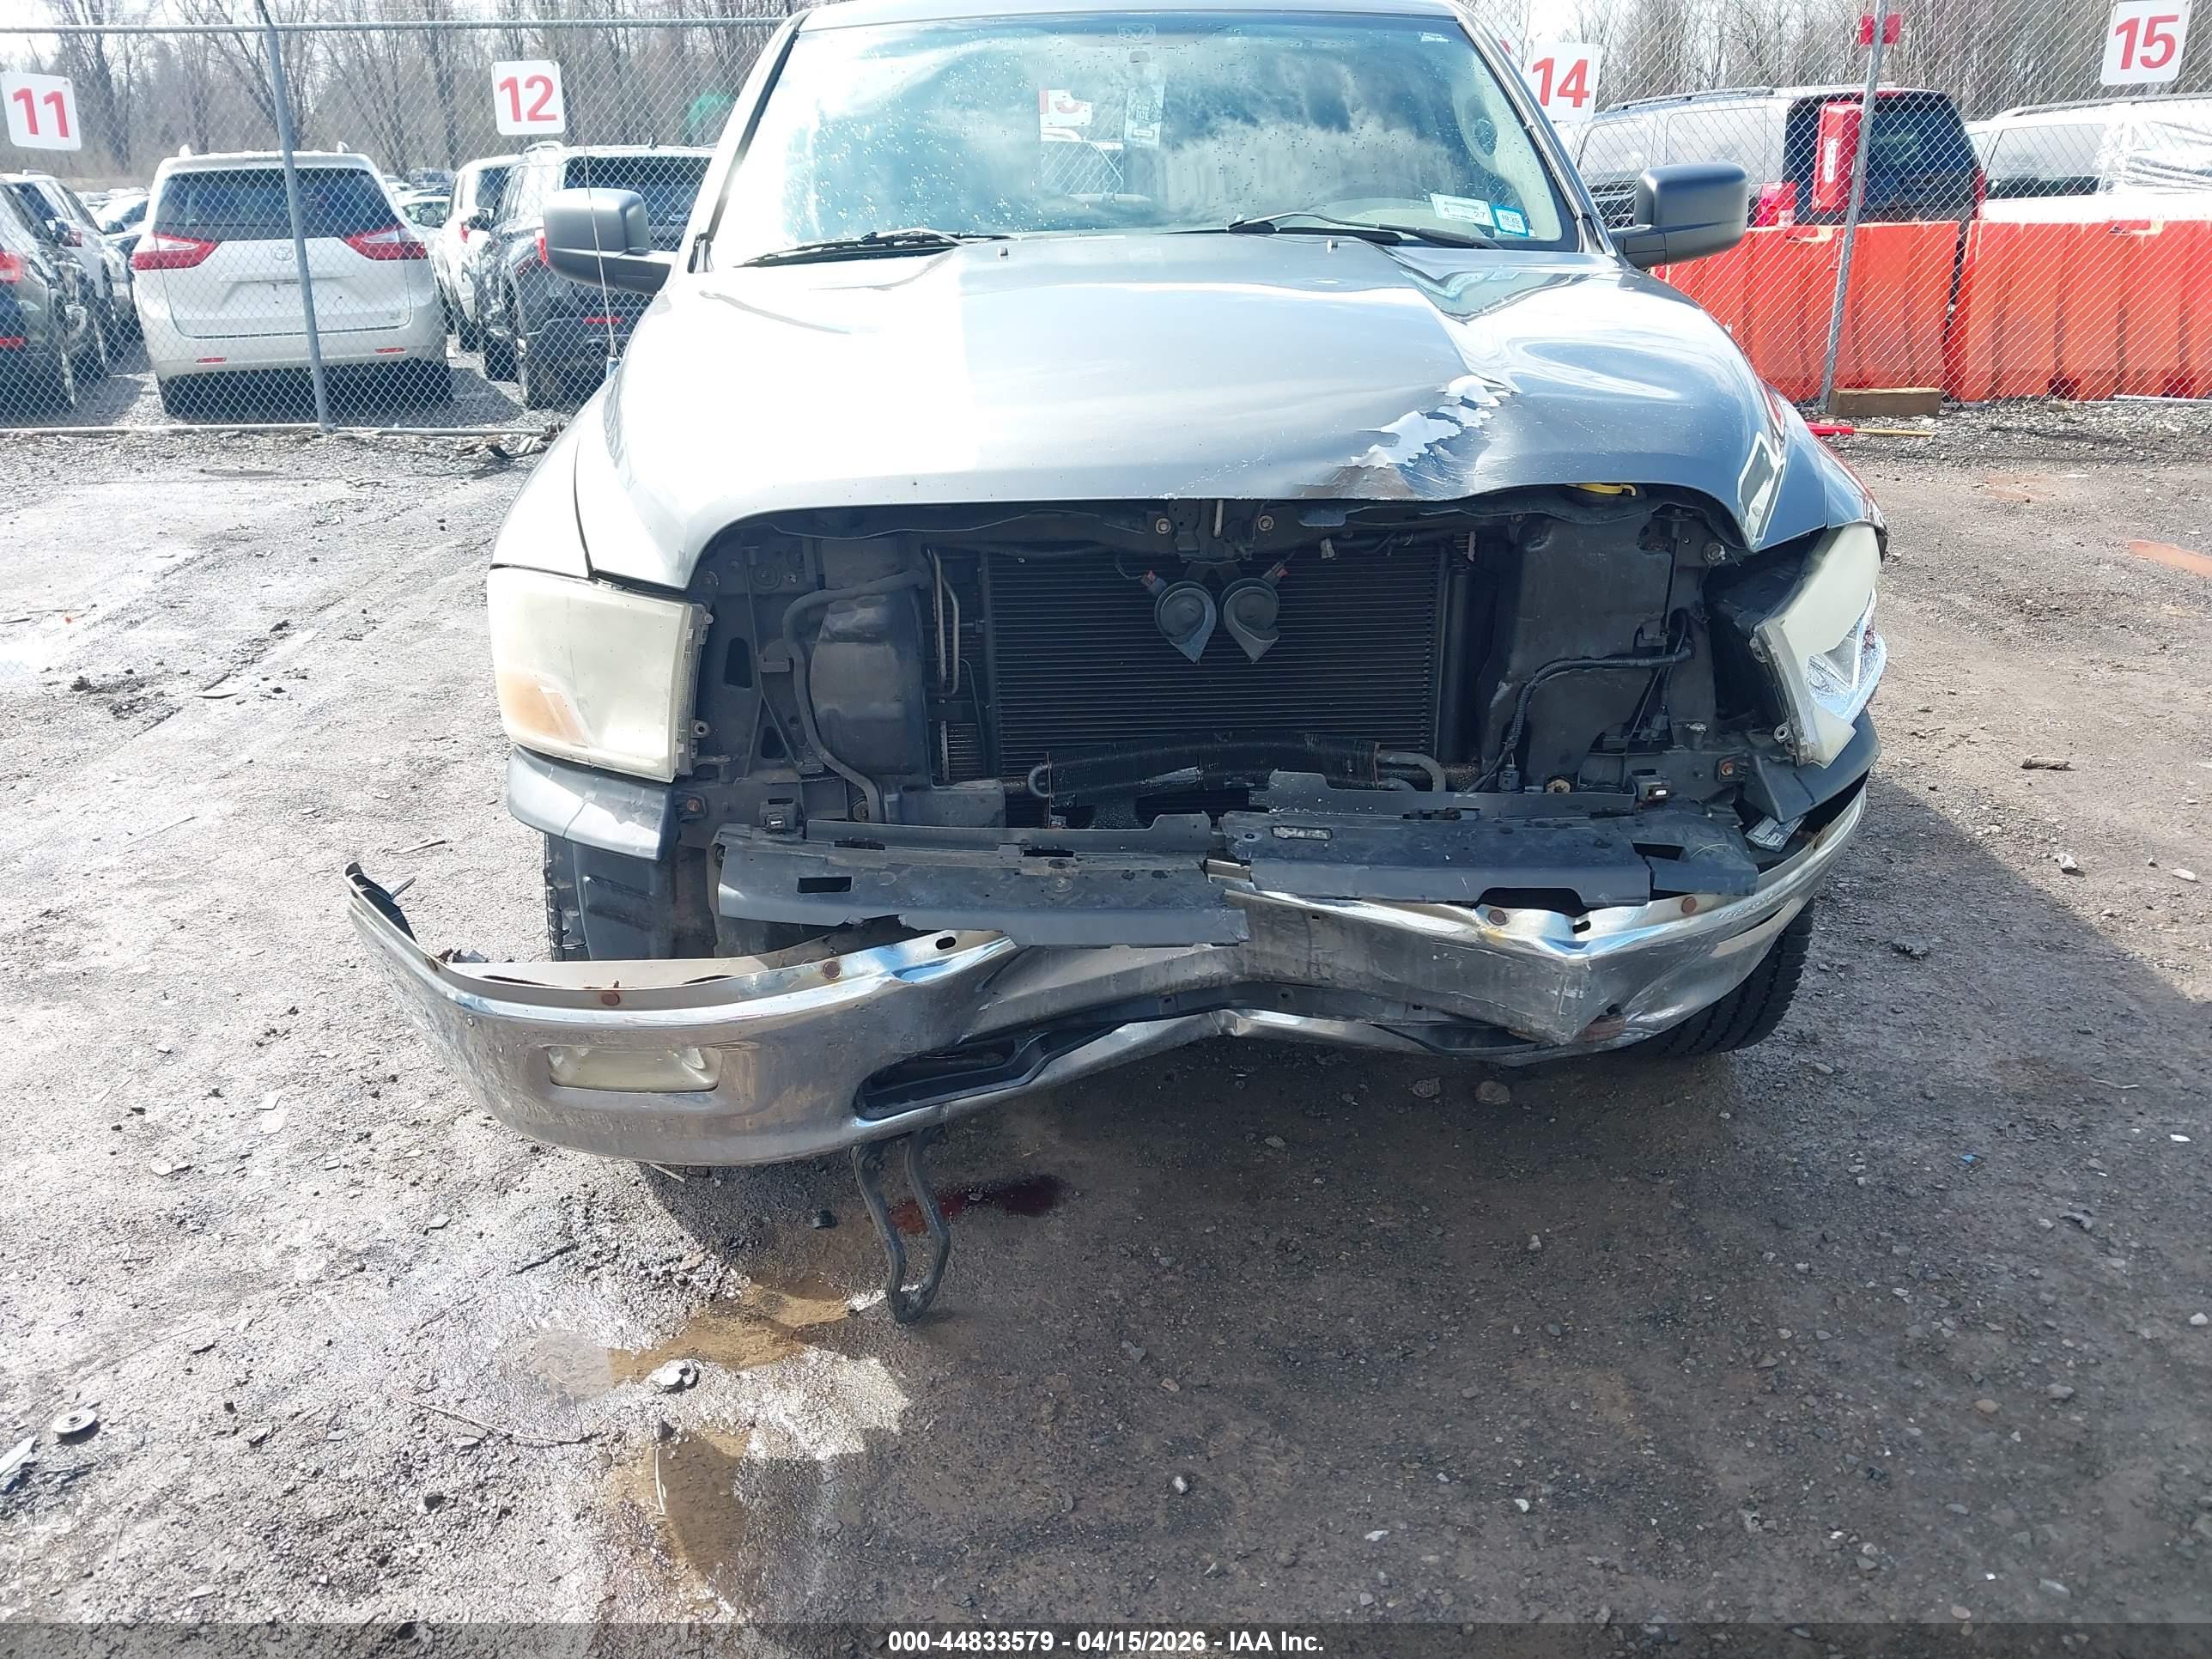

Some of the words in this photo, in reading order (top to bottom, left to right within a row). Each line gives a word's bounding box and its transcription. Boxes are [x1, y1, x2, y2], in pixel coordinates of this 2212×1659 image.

[2115, 15, 2178, 70] 15
[500, 75, 558, 121] 12
[1532, 57, 1590, 107] 14
[12, 88, 70, 137] 11
